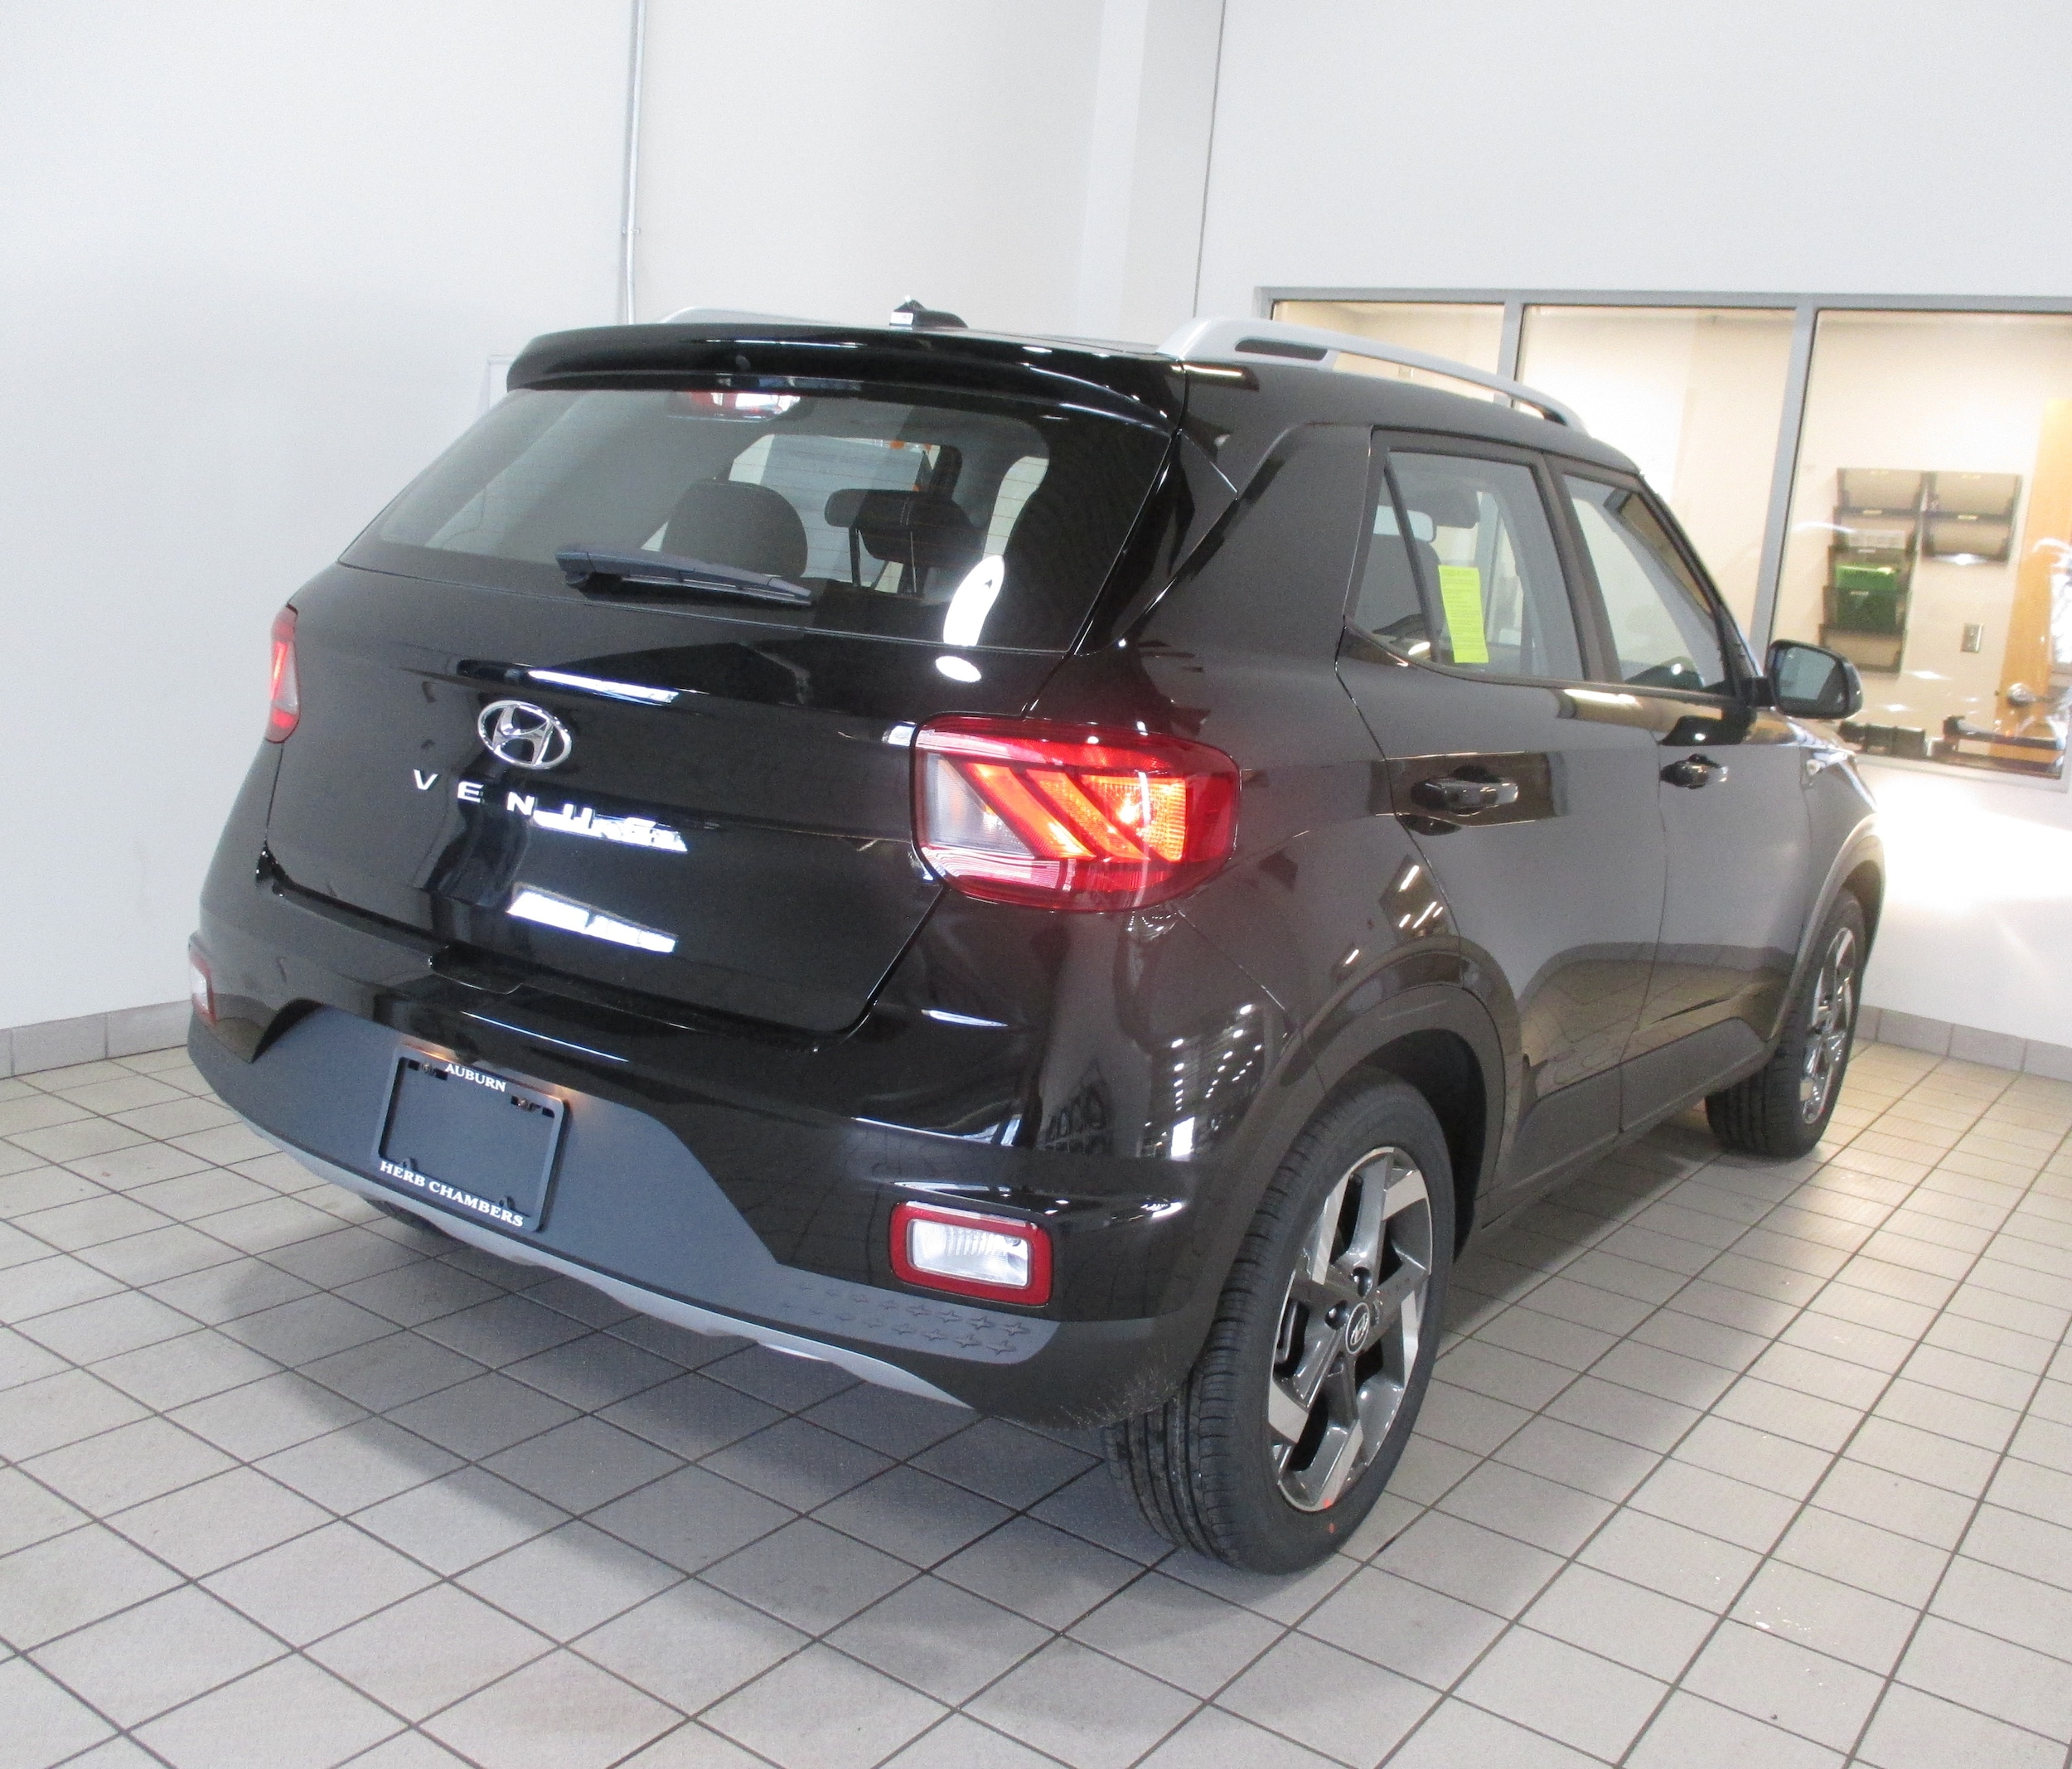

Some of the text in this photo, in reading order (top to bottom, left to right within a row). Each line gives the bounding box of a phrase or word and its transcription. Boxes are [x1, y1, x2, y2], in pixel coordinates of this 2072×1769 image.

[444, 1063, 506, 1093] AUBURN
[380, 1161, 524, 1227] HERB CHAMBERS
